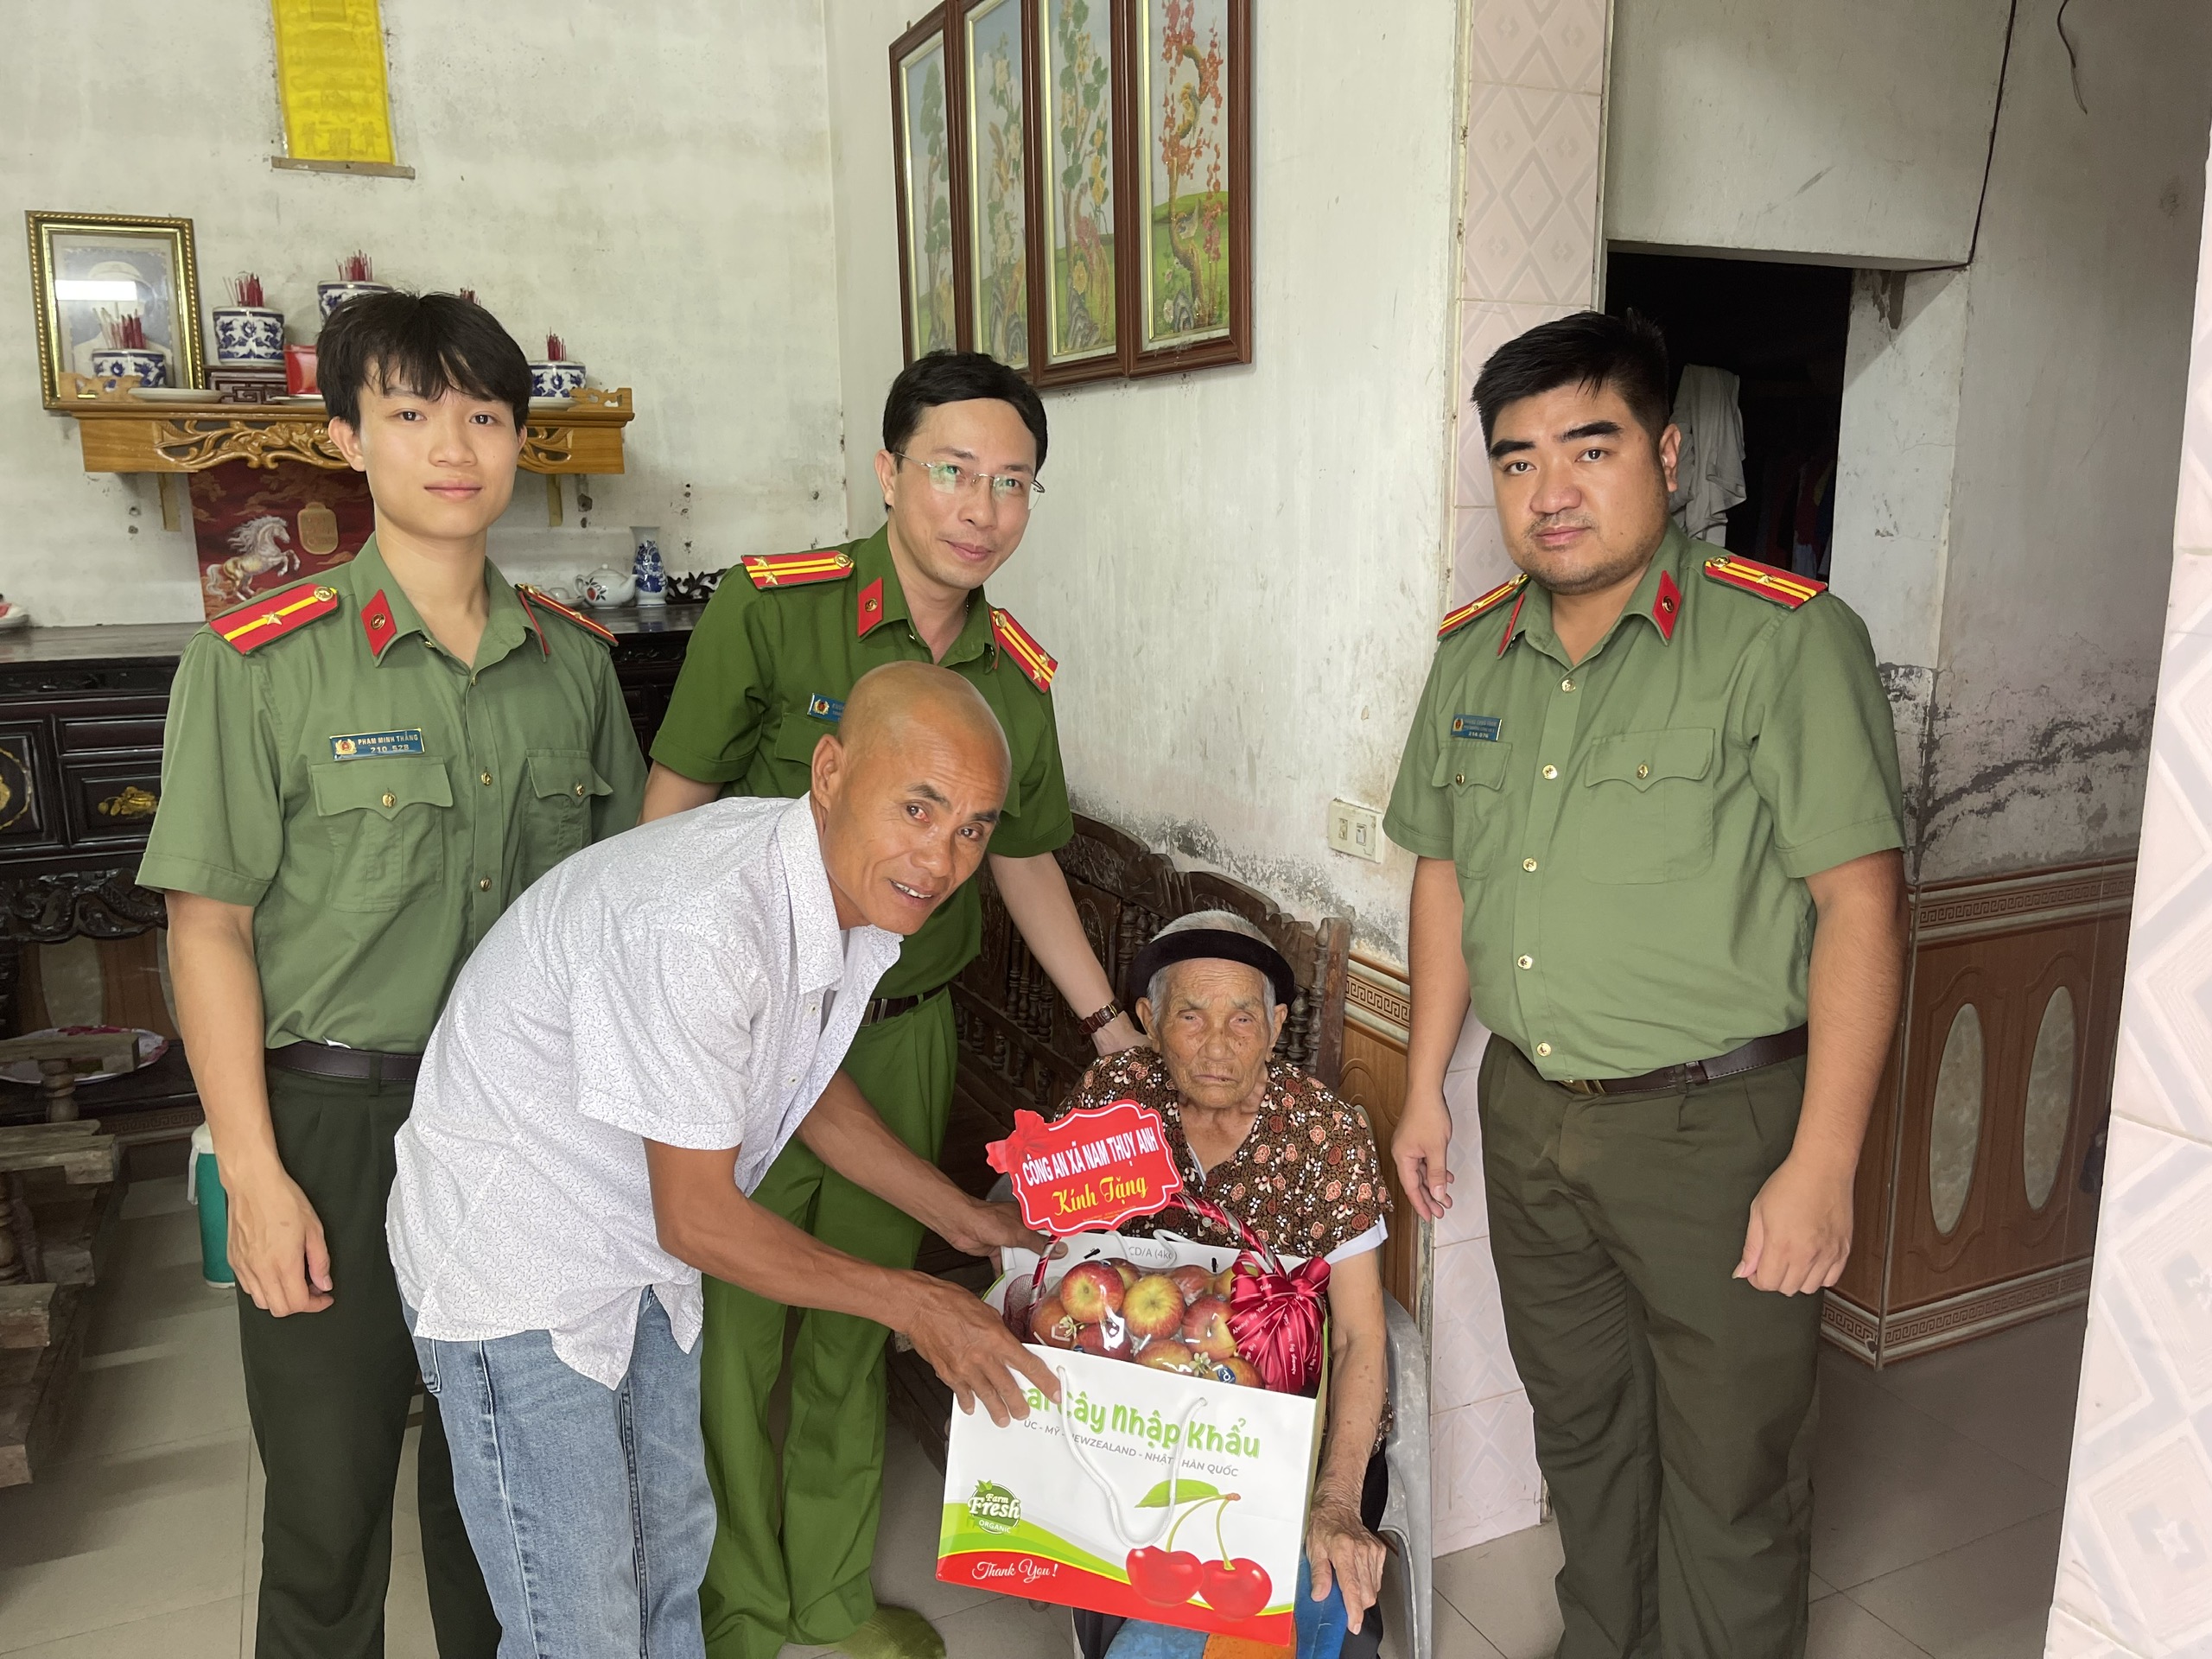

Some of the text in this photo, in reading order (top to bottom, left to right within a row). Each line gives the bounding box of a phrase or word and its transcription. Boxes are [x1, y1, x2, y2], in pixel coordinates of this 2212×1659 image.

[358, 737, 377, 746] PHẠM
[391, 744, 410, 753] 528
[1022, 1127, 1159, 1186] CÔNG AN XÃ NAM THỤY ANH
[1052, 1183, 1099, 1216] Kính
[1099, 1176, 1149, 1205] Tặng
[1128, 1246, 1153, 1257] CD/A
[1186, 1417, 1261, 1459] Khẩu
[1045, 1425, 1061, 1437] MỸ
[1071, 1433, 1137, 1457] EWZEALAND
[1144, 1452, 1174, 1465] NHẬT
[1181, 1459, 1205, 1471] HÀN
[1207, 1464, 1239, 1478] QUỐC
[967, 1496, 1020, 1519] Fresh
[985, 1493, 1009, 1503] Farm
[978, 1519, 1012, 1534] ORGANIC
[972, 1560, 1017, 1580] Thank
